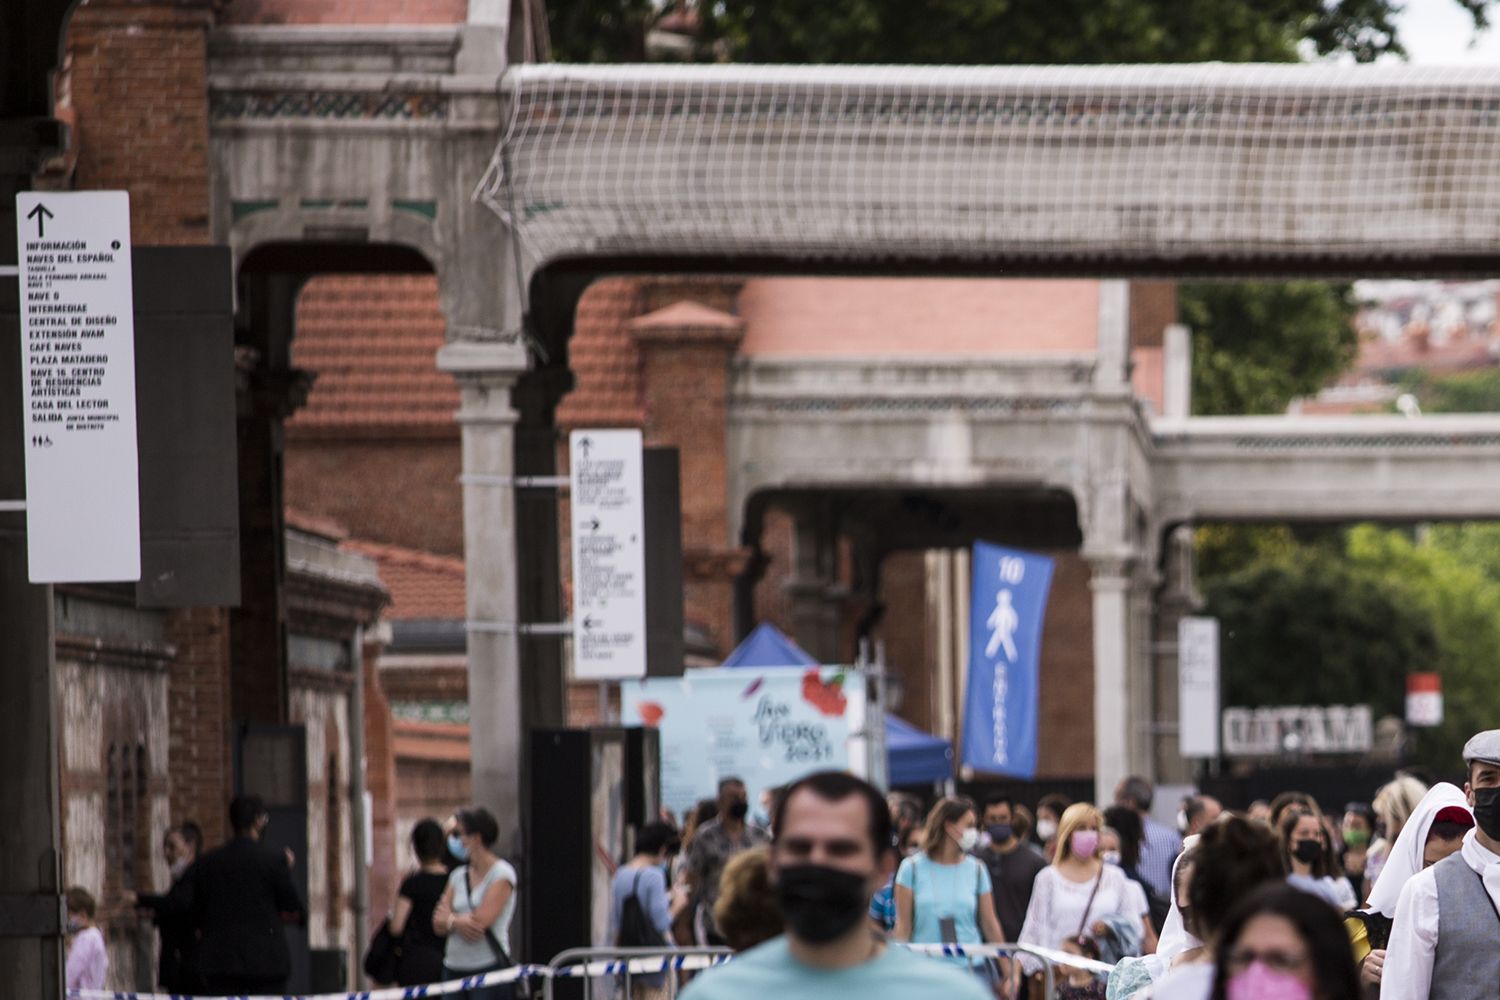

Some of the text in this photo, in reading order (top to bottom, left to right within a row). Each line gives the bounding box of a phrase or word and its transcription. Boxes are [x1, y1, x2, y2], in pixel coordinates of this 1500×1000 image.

[26, 241, 87, 251] INFORMACIÓN
[27, 253, 114, 264] NAVES DEL ESPAÑOL
[28, 292, 50, 301] NAVE
[28, 304, 87, 314] INTERMEDIAE
[29, 315, 117, 327] CENTRAL DE DISEÑO
[29, 328, 105, 340] EXTENSIÓN AVAM
[30, 341, 82, 352] CAFÉ NAVES
[30, 355, 108, 365] PLAZA MATADERO
[31, 368, 53, 378] NAVE
[71, 367, 105, 377] CENTRO
[31, 377, 101, 387] DE RESIDENCIAS
[31, 386, 81, 397] ARTÍSTICAS
[31, 400, 109, 410] CASA DEL LECTOR
[32, 413, 63, 423] SALIDA
[998, 555, 1026, 585] 10
